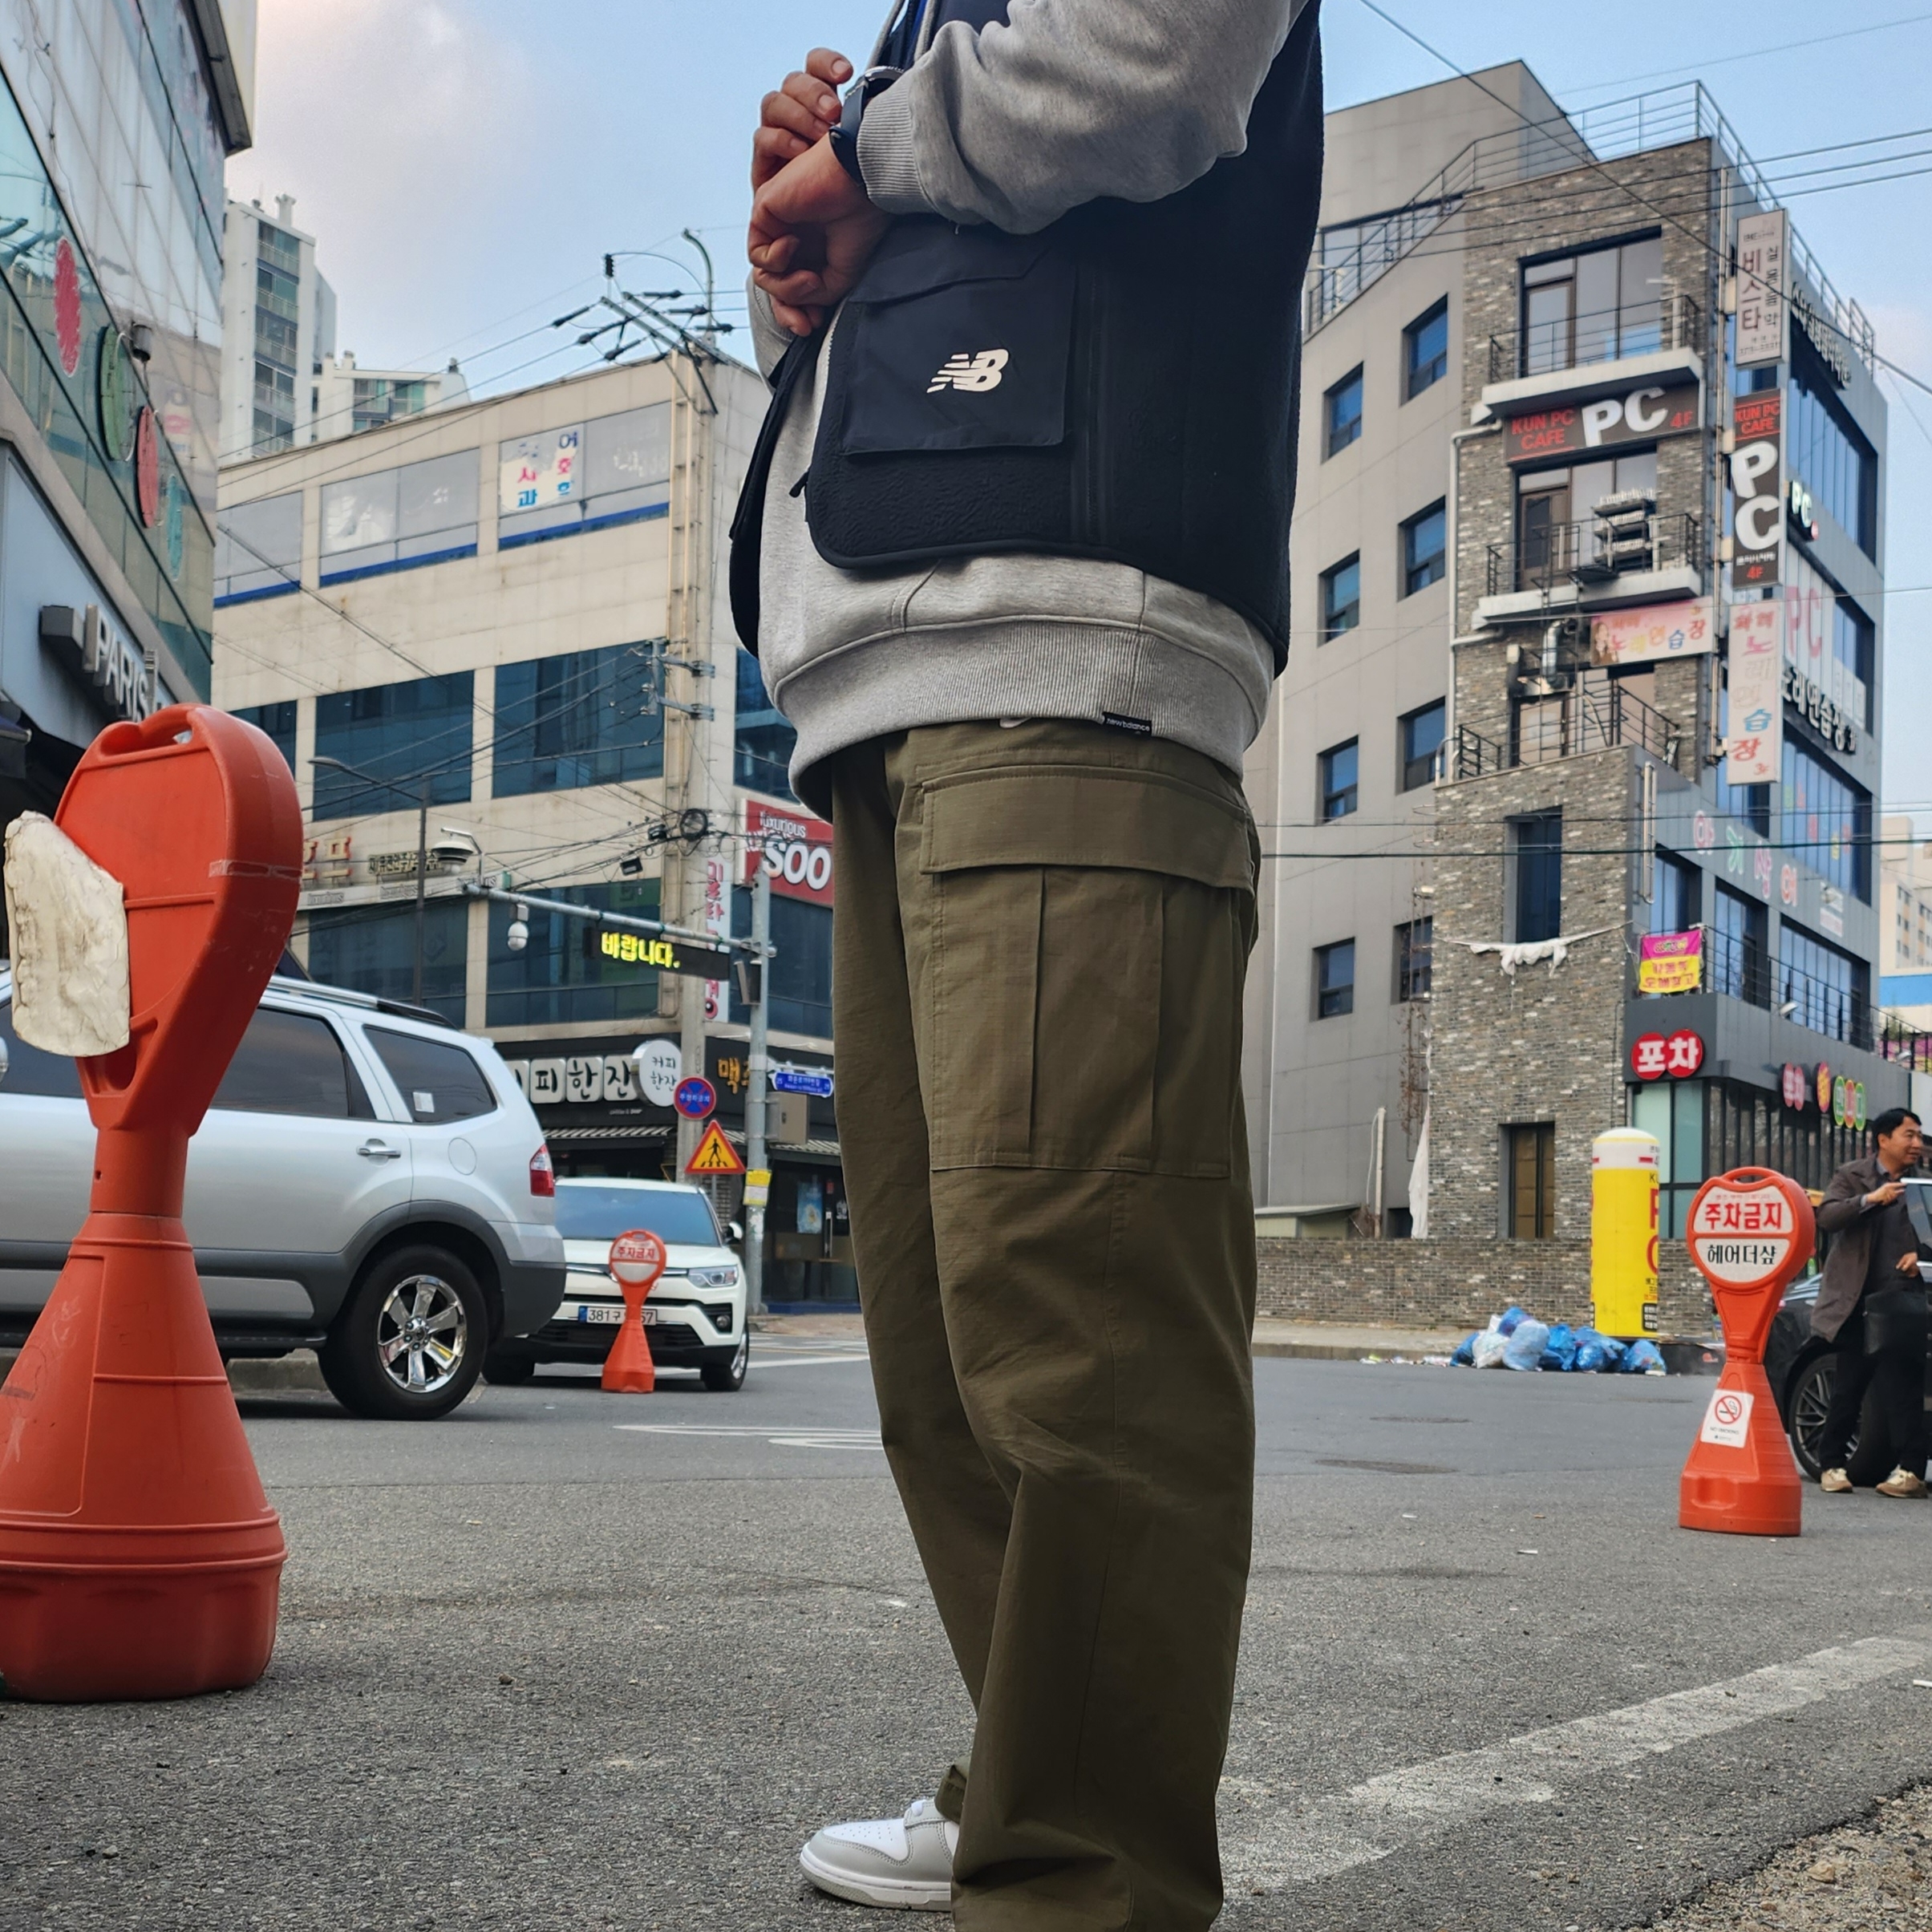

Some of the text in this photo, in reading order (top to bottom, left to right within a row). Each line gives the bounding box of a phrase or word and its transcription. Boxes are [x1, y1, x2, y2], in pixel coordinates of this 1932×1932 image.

[1741, 248, 1762, 332] 비스타
[1511, 407, 1574, 435] KUN PC
[1582, 386, 1668, 448] PC
[1670, 411, 1693, 429] 4F
[1735, 401, 1780, 423] KUN PC
[1741, 417, 1775, 435] CAFE
[1521, 429, 1565, 450] CAFE
[1731, 440, 1782, 551] PC
[1791, 480, 1813, 529] PC
[1747, 566, 1764, 579] 4F
[1610, 618, 1707, 654] 노래연습장
[87, 605, 151, 720] PARIS
[1731, 635, 1777, 762] 노래연습장
[1106, 718, 1151, 731] new balance
[759, 811, 806, 839] luxurious
[763, 834, 832, 891] SOO
[601, 931, 681, 969] 바랍니다.
[651, 1055, 677, 1069] 커피
[1637, 1037, 1699, 1073] 포차
[650, 1071, 678, 1092] 한잔
[1705, 1202, 1782, 1230] 주차금지
[1707, 1244, 1777, 1266] 헤어더샾
